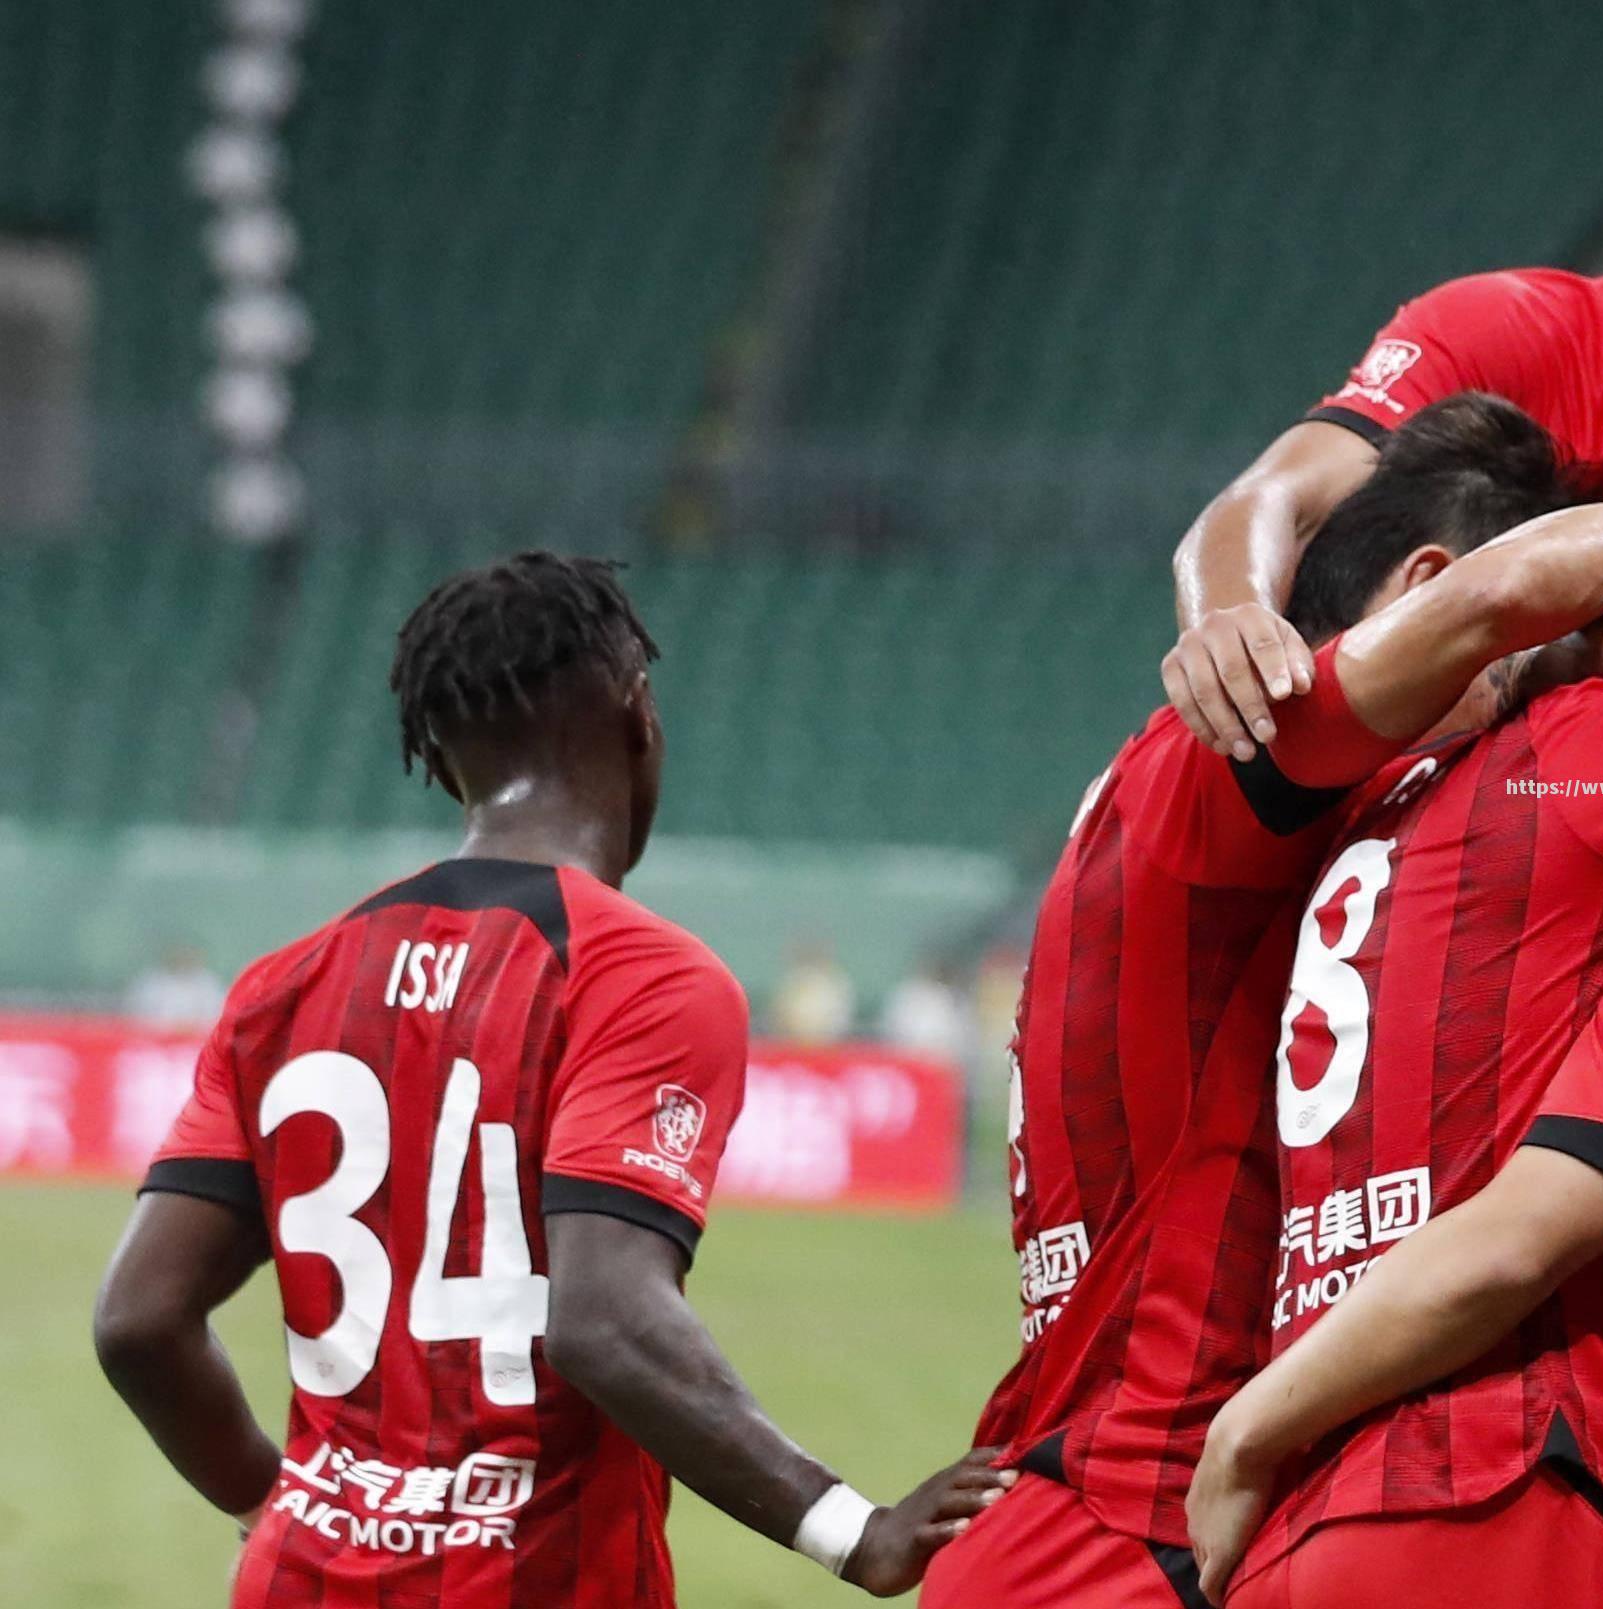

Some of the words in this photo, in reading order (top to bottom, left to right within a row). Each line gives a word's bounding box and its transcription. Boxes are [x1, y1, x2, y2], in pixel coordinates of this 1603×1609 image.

[384, 938, 470, 1013] ISSA
[1276, 836, 1398, 1149] 8
[259, 1050, 550, 1407] 34
[281, 1441, 537, 1517] 上汽集团
[350, 1516, 516, 1556] MOTOR
